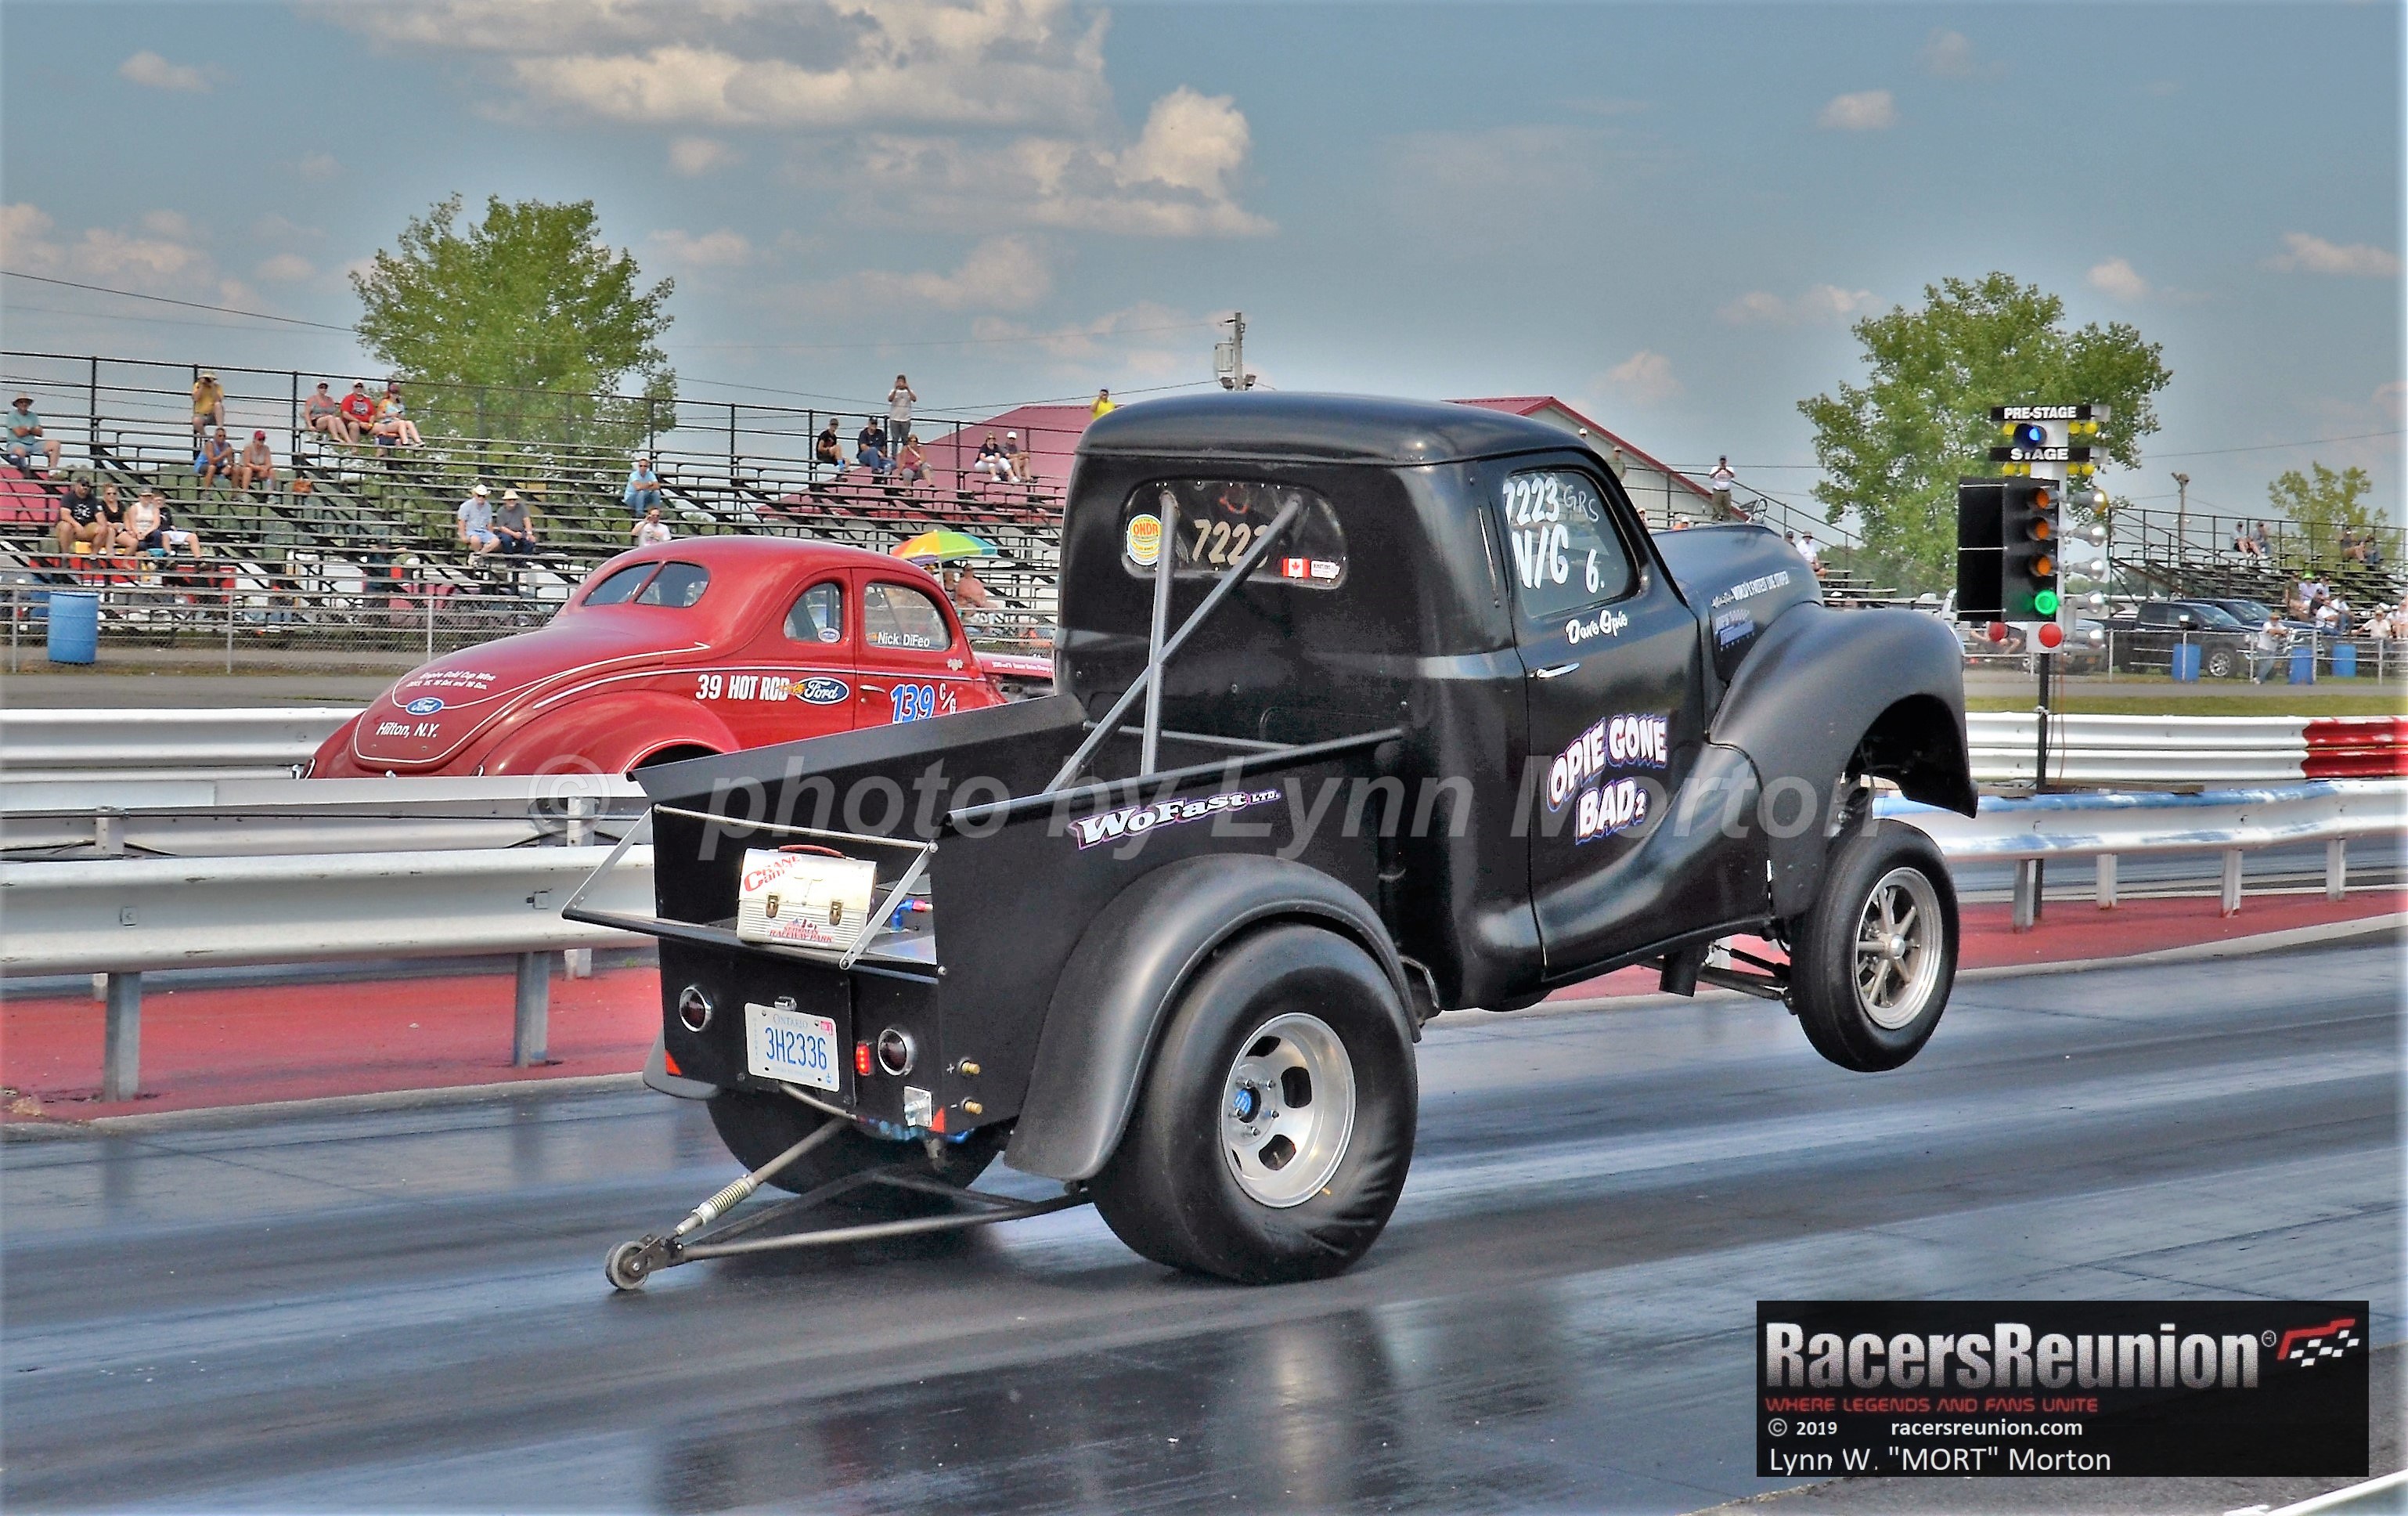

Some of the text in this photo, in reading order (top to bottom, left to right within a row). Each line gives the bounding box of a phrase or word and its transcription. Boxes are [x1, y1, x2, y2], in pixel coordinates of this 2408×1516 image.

[2003, 406, 2077, 420] PRE-STAGE
[1503, 476, 1559, 526] 7223
[1563, 485, 1599, 522] GRS
[878, 630, 930, 648] Nick DiFeo
[1565, 609, 1628, 644] Dave Opie
[410, 698, 438, 713] Ford
[695, 674, 839, 702] 39 HOT ROD Ford
[891, 683, 936, 724] 139
[376, 721, 440, 738] Hilton, N.Y.
[1548, 714, 1667, 808] OPIE GONE
[1076, 792, 1246, 845] WoFast
[1577, 778, 1647, 840] BAD 2
[809, 934, 833, 943] PARK
[773, 1013, 809, 1029] ONTARIO
[765, 1027, 827, 1070] 3H2336
